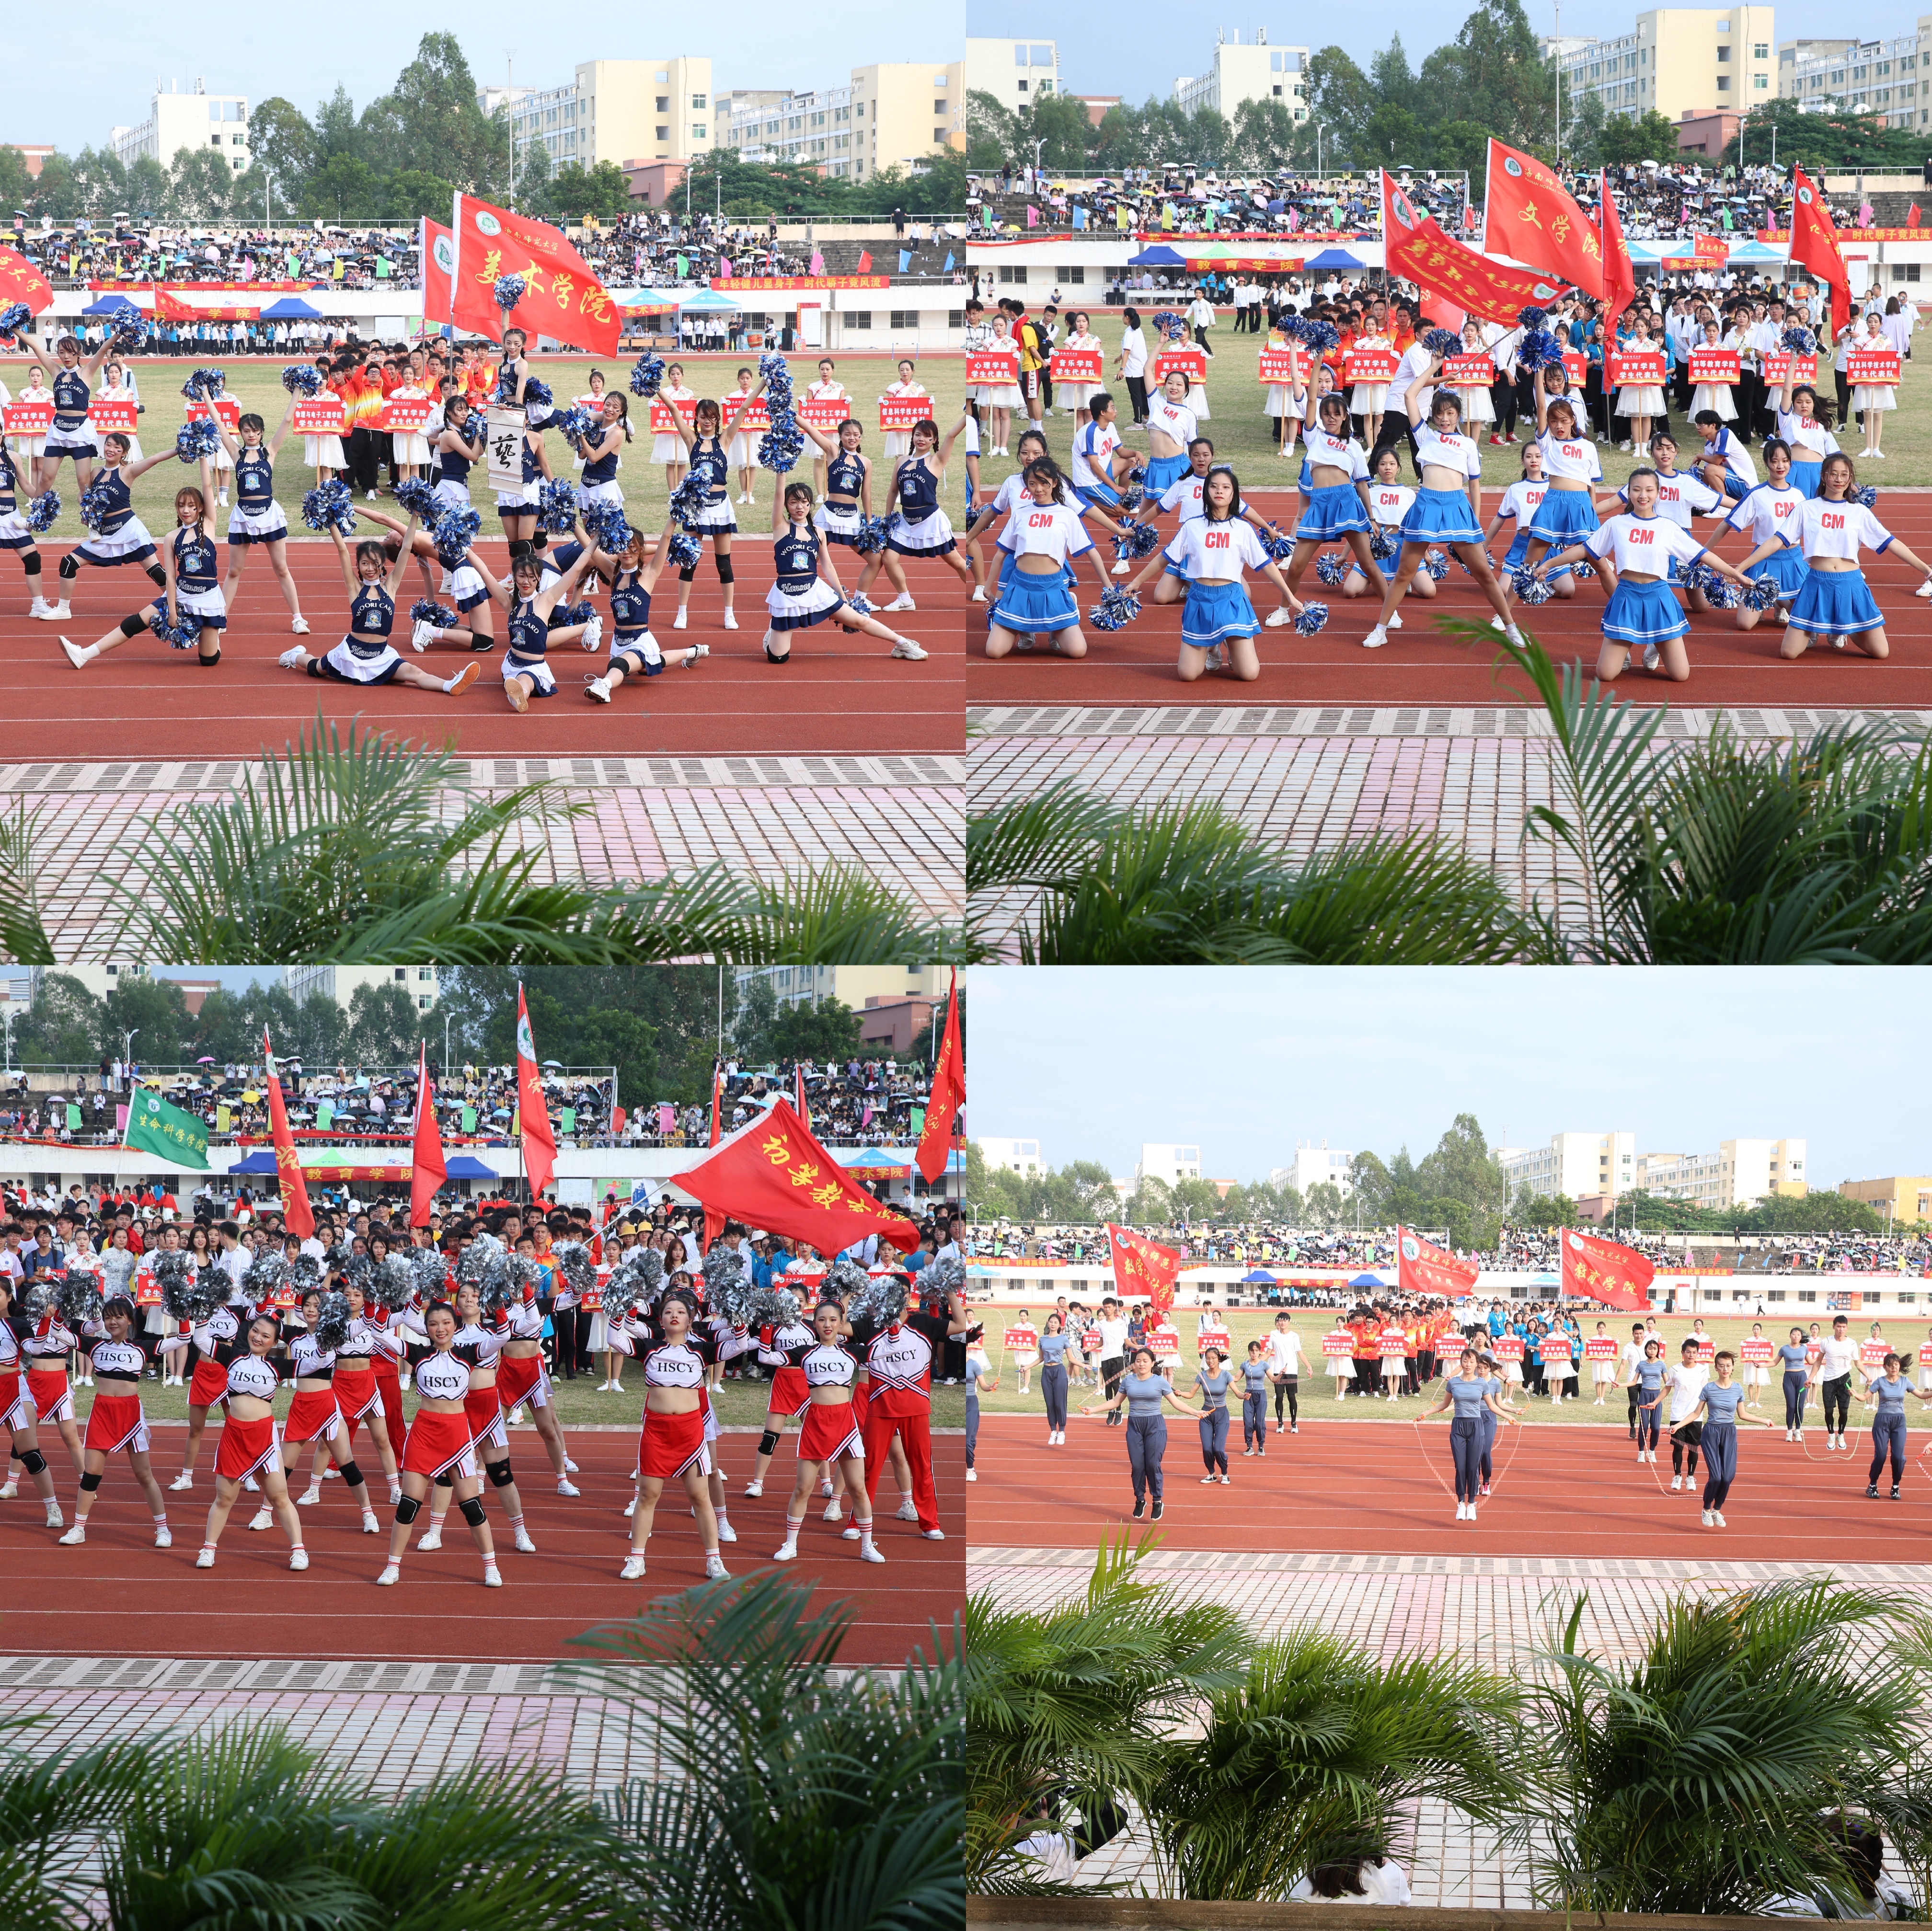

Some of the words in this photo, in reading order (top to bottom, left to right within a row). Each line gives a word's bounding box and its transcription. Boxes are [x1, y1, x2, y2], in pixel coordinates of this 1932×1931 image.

[1525, 178, 1539, 186] HAINAN
[1540, 184, 1557, 193] NORMAL
[1518, 200, 1602, 263] 文学院
[1852, 230, 1931, 241] 时代骄子竞风流
[505, 227, 558, 251] 海南师范大学
[519, 241, 534, 250] NORMAL
[536, 247, 557, 256] UNIVERSITY
[1698, 242, 1726, 253] 美术学院
[1196, 260, 1295, 271] 教育学院
[1669, 258, 1718, 269] 美术学院
[719, 279, 795, 290] 年轻健儿显身手
[805, 277, 881, 288] 时代骄子竞风流
[152, 308, 251, 320] 教学院
[626, 304, 673, 316] 美术学院
[974, 361, 1009, 369] 心理学院
[1059, 359, 1093, 368] 音乐学院
[1261, 360, 1309, 369] 物理与电子工学院
[1354, 359, 1388, 368] 体育学院
[1445, 362, 1489, 370] 国际教育学院
[1692, 360, 1736, 368] 初等教育学院
[1849, 361, 1897, 369] 信息科学技术学院
[971, 370, 1011, 378] 学生代表队
[1056, 368, 1096, 376] 学生代表队
[1160, 370, 1199, 378] 学表队
[1351, 368, 1391, 377] 学生代表队
[1448, 371, 1487, 379] 生代表队
[1619, 371, 1659, 379] 学生代表队
[1693, 369, 1734, 378] 学生代表队
[1770, 371, 1811, 379] 学生表队
[1852, 370, 1894, 378] 学生代表队
[69, 385, 83, 394] CARD
[296, 411, 342, 419] 物理与电子工程学院
[392, 408, 426, 417] 体育学院
[55, 419, 80, 429] Hansae
[389, 417, 428, 425] 学生代表队
[1801, 416, 1819, 430] CM
[1563, 444, 1582, 460] CM
[710, 456, 723, 468] CARD
[255, 467, 269, 478] CARD
[832, 467, 853, 475] WOORI
[912, 473, 925, 483] CARD
[106, 484, 119, 495] CARD
[1659, 486, 1679, 501] CM
[1380, 493, 1399, 506] CM
[1527, 492, 1545, 504] CM
[242, 505, 266, 514] Hansae
[1774, 502, 1795, 517] CM
[1029, 513, 1053, 528] CM
[1822, 513, 1844, 529] CM
[1205, 532, 1230, 548] CM
[1629, 529, 1654, 544] CM
[781, 544, 805, 556] WOORI
[178, 580, 206, 592] Hansae
[781, 583, 811, 592] Hansae
[610, 594, 624, 602] OORI
[625, 593, 642, 605] CARD
[356, 603, 377, 616] WOORI
[379, 603, 392, 616] CARD
[522, 621, 539, 634] CARD
[351, 645, 380, 657] Hansae
[139, 1114, 207, 1152] 生命科学学院
[307, 1168, 413, 1180] 教育学院
[848, 1167, 904, 1179] 美术学院
[966, 1257, 1010, 1266] 激情燃烧希望
[1420, 1259, 1434, 1268] HAINAN
[1421, 1248, 1476, 1276] 海南师范大学
[1575, 1262, 1637, 1295] 教育学院
[208, 1321, 231, 1331] SCY
[780, 1338, 810, 1348] HSCY
[100, 1352, 136, 1363] HSCY
[886, 1349, 917, 1362] HSCY
[657, 1362, 694, 1373] HSCY
[808, 1362, 847, 1374] HSCY
[233, 1371, 269, 1385] HSCY
[424, 1375, 461, 1388] HSCY
